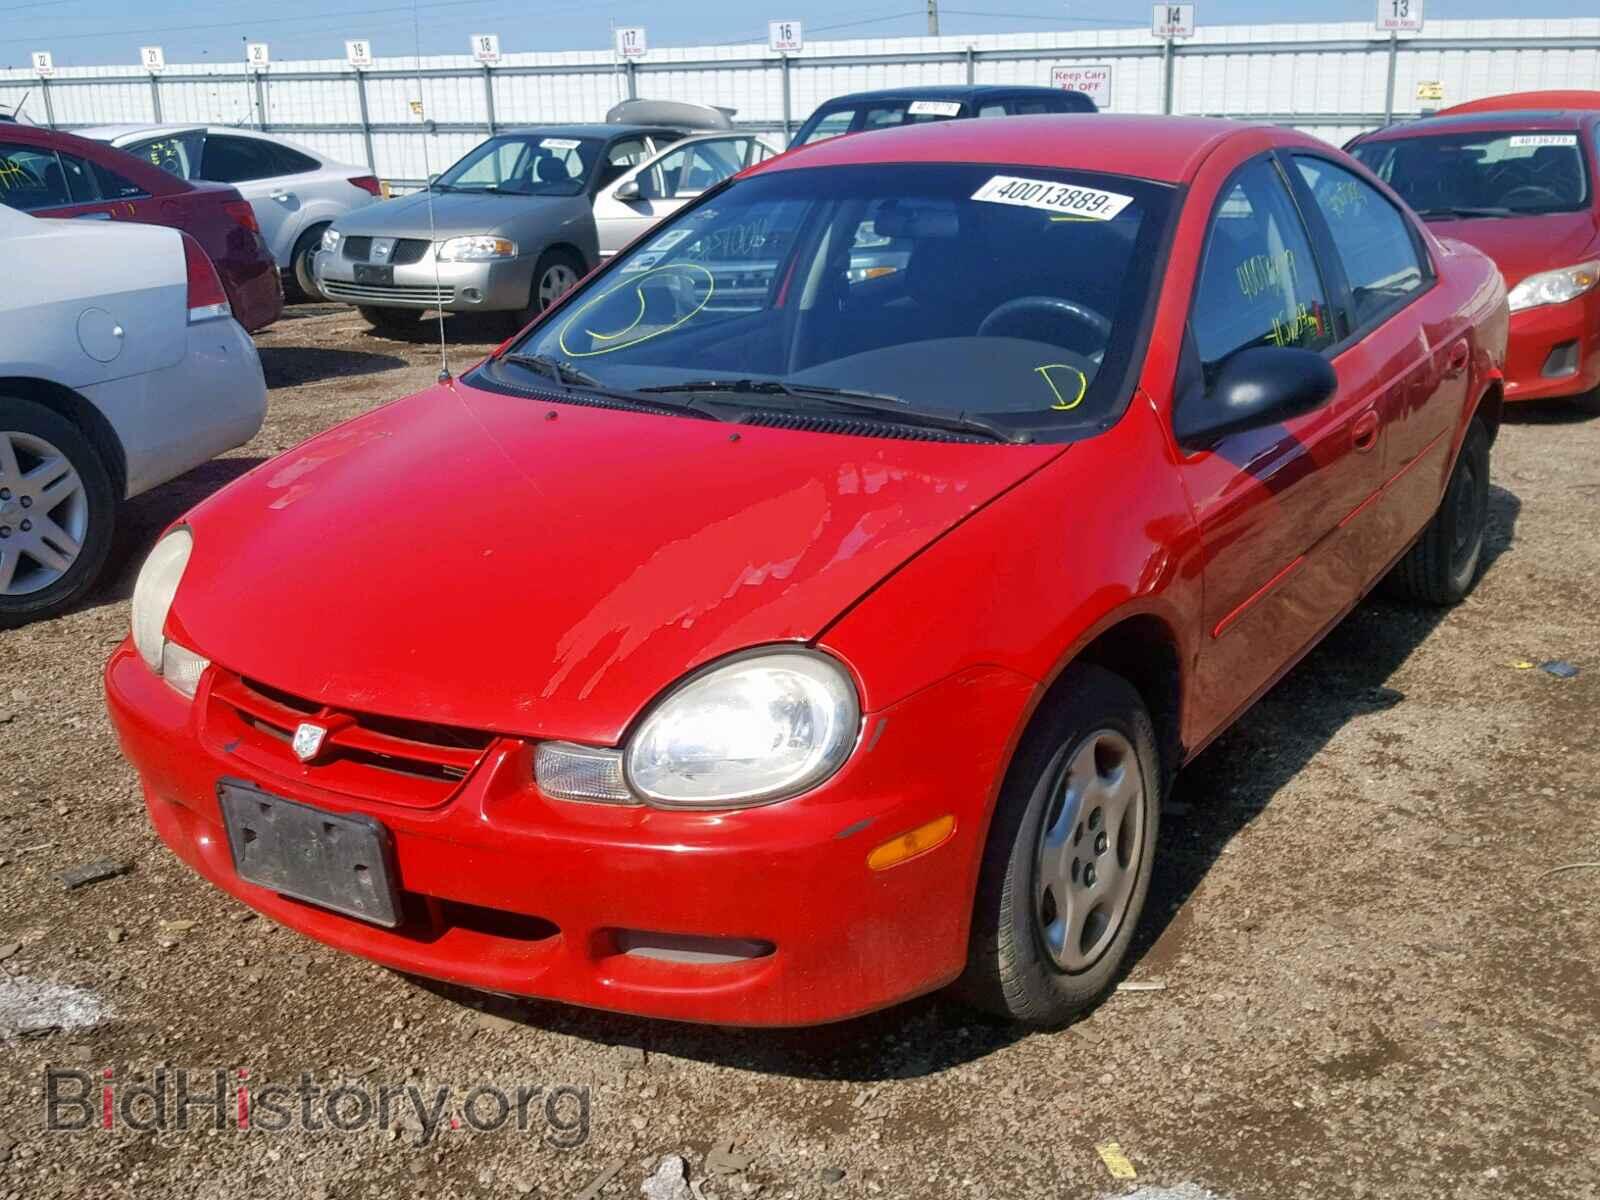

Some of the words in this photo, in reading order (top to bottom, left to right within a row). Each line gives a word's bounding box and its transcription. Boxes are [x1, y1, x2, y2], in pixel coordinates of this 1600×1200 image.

[1166, 6, 1181, 25] 14
[1391, 0, 1409, 18] 13
[624, 30, 637, 47] 17
[778, 23, 793, 41] 16
[353, 43, 364, 57] 19
[479, 37, 492, 53] 18
[1055, 71, 1082, 81] Keep
[1084, 70, 1106, 80] Cars
[1079, 82, 1101, 92] OFF
[997, 181, 1110, 213] 40013889
